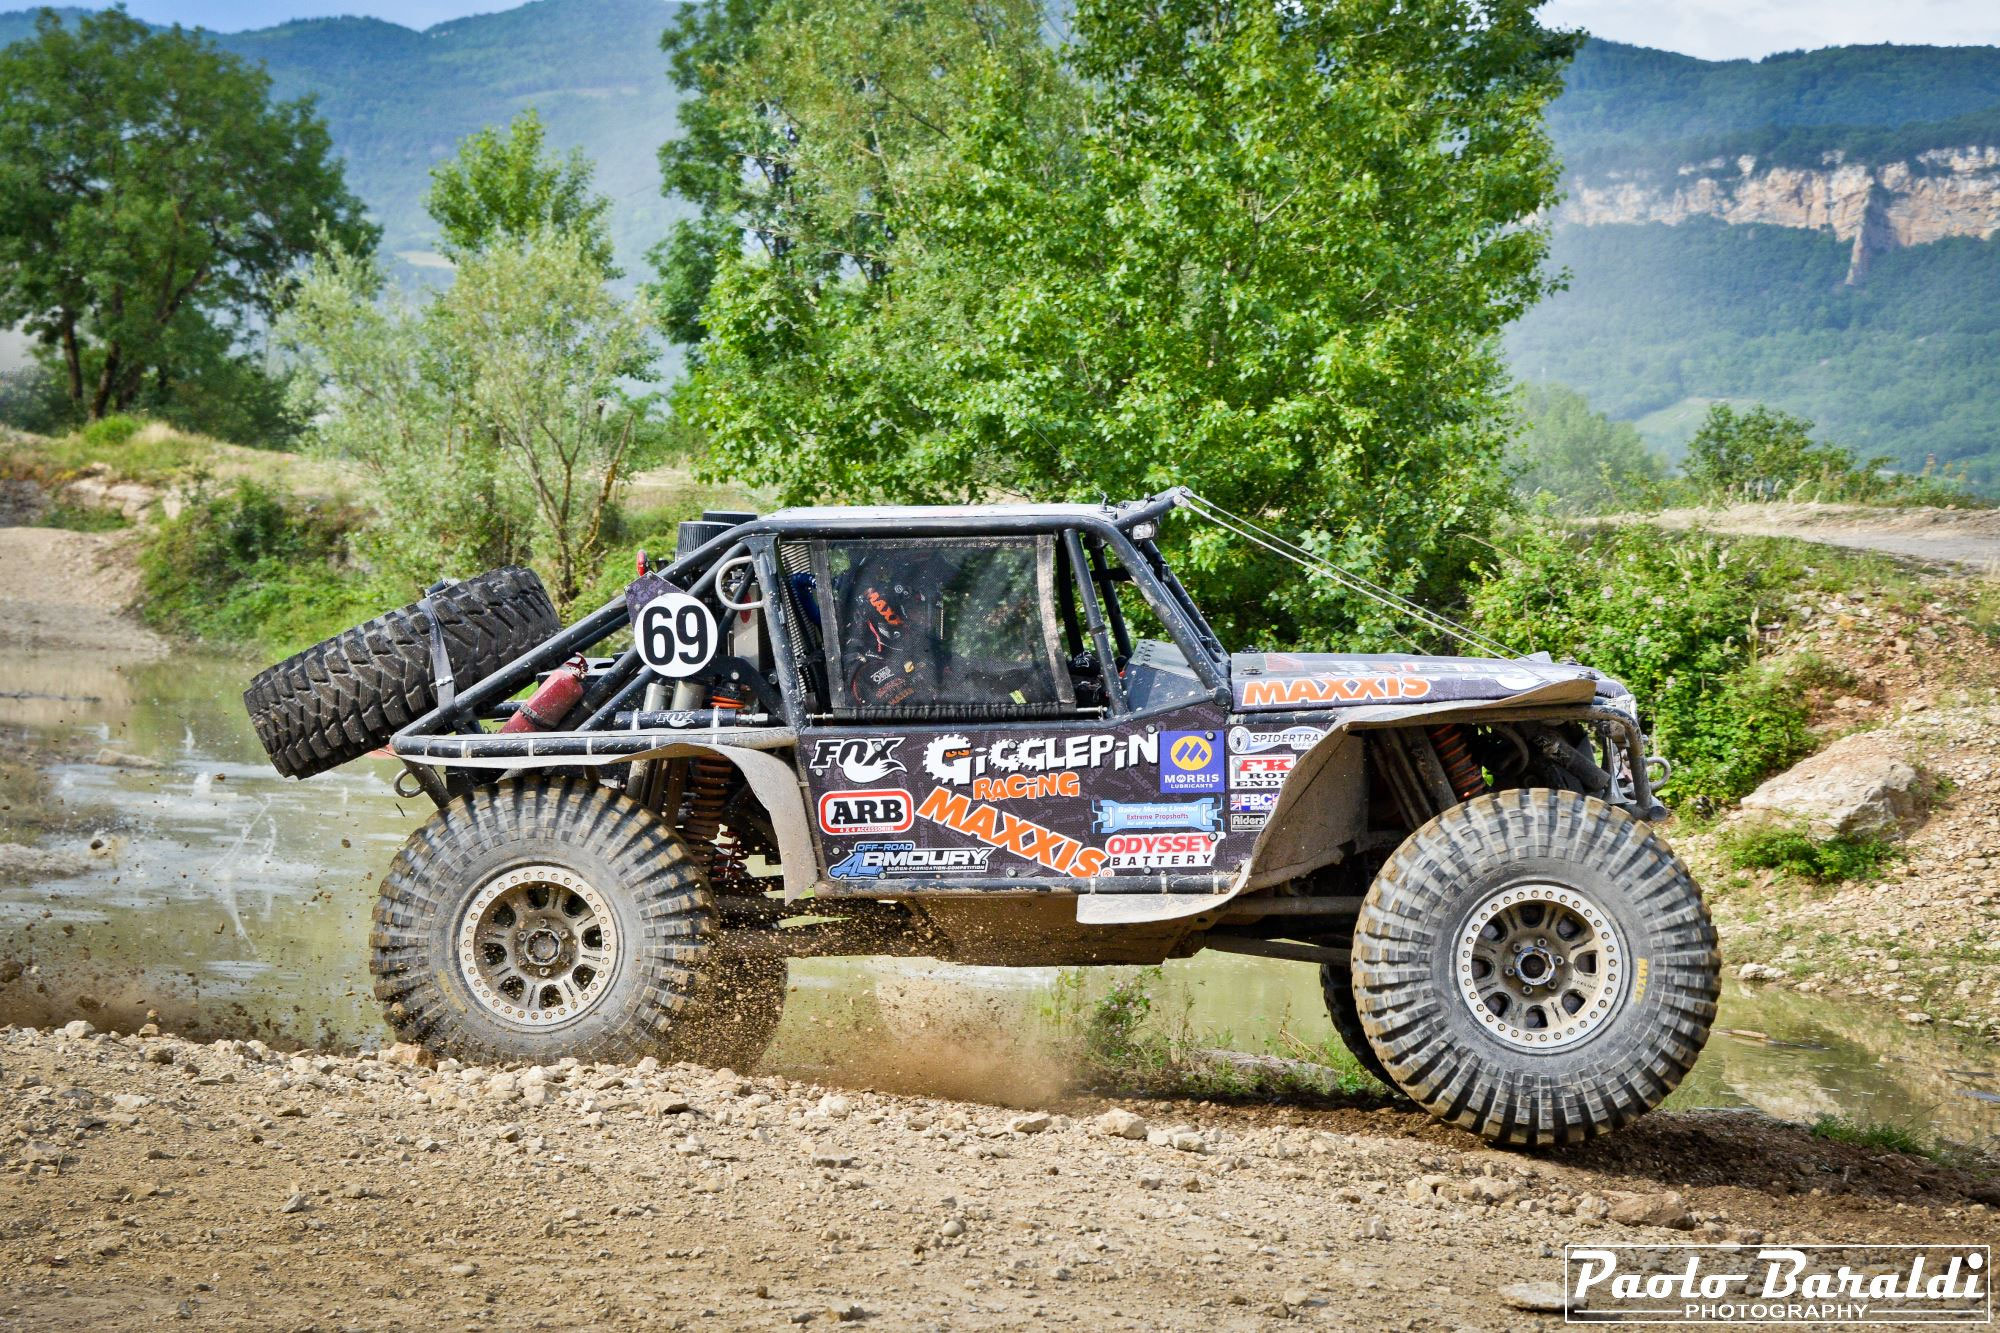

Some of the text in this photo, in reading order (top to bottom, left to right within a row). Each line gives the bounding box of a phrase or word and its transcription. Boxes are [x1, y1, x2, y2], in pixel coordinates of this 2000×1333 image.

[642, 605, 708, 665] 69
[1243, 676, 1431, 704] MAXXIS
[656, 712, 695, 725] FOX
[1252, 734, 1324, 743] SPIDERTRA
[809, 737, 907, 775] FOX
[1240, 759, 1292, 771] FK
[1164, 774, 1219, 783] MORRIS
[1241, 794, 1272, 805] EBC
[831, 799, 904, 825] ARB
[1233, 816, 1264, 825] Alders
[916, 786, 1109, 877] MAXXIS
[1107, 835, 1216, 854] ODYSSEY
[1112, 855, 1211, 866] BATTERY
